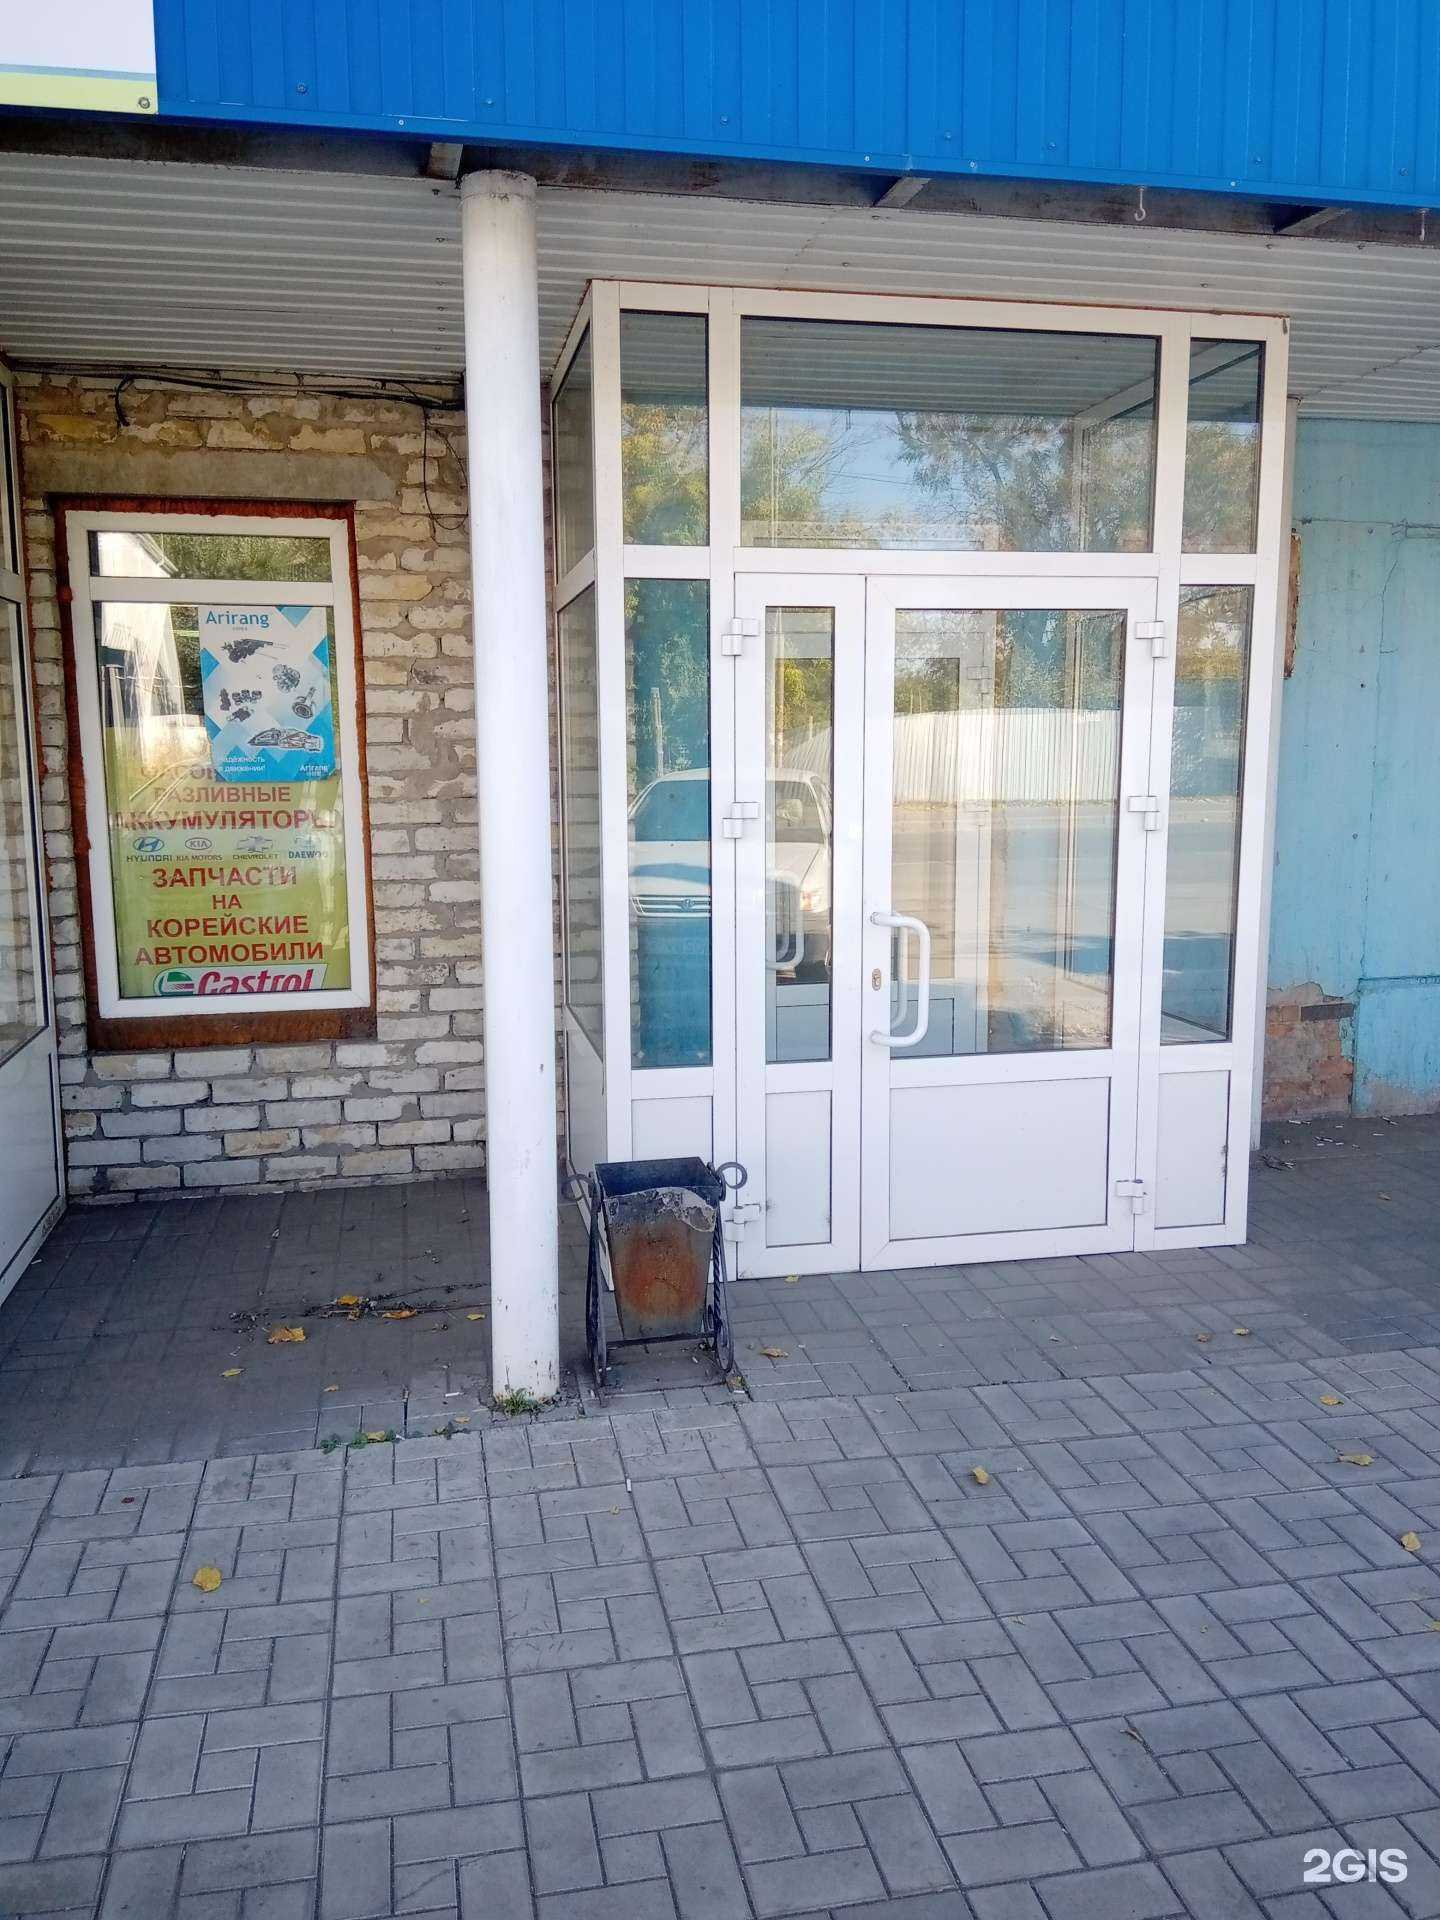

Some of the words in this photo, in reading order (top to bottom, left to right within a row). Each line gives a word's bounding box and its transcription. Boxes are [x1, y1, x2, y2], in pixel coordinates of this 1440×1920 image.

[206, 611, 269, 628] Arirang
[300, 764, 328, 773] Arirang
[154, 786, 292, 803] РАЗЛИВНЫЕ
[232, 853, 278, 861] CHEVROLET
[288, 850, 328, 859] DAEWOO
[152, 866, 297, 888] ЗАПЧАСТИ
[212, 894, 242, 910] НА
[147, 913, 309, 938] КОРЕЙСКИЕ
[134, 942, 324, 965] АВТОМОБИЛИ
[197, 969, 314, 996] Castrol
